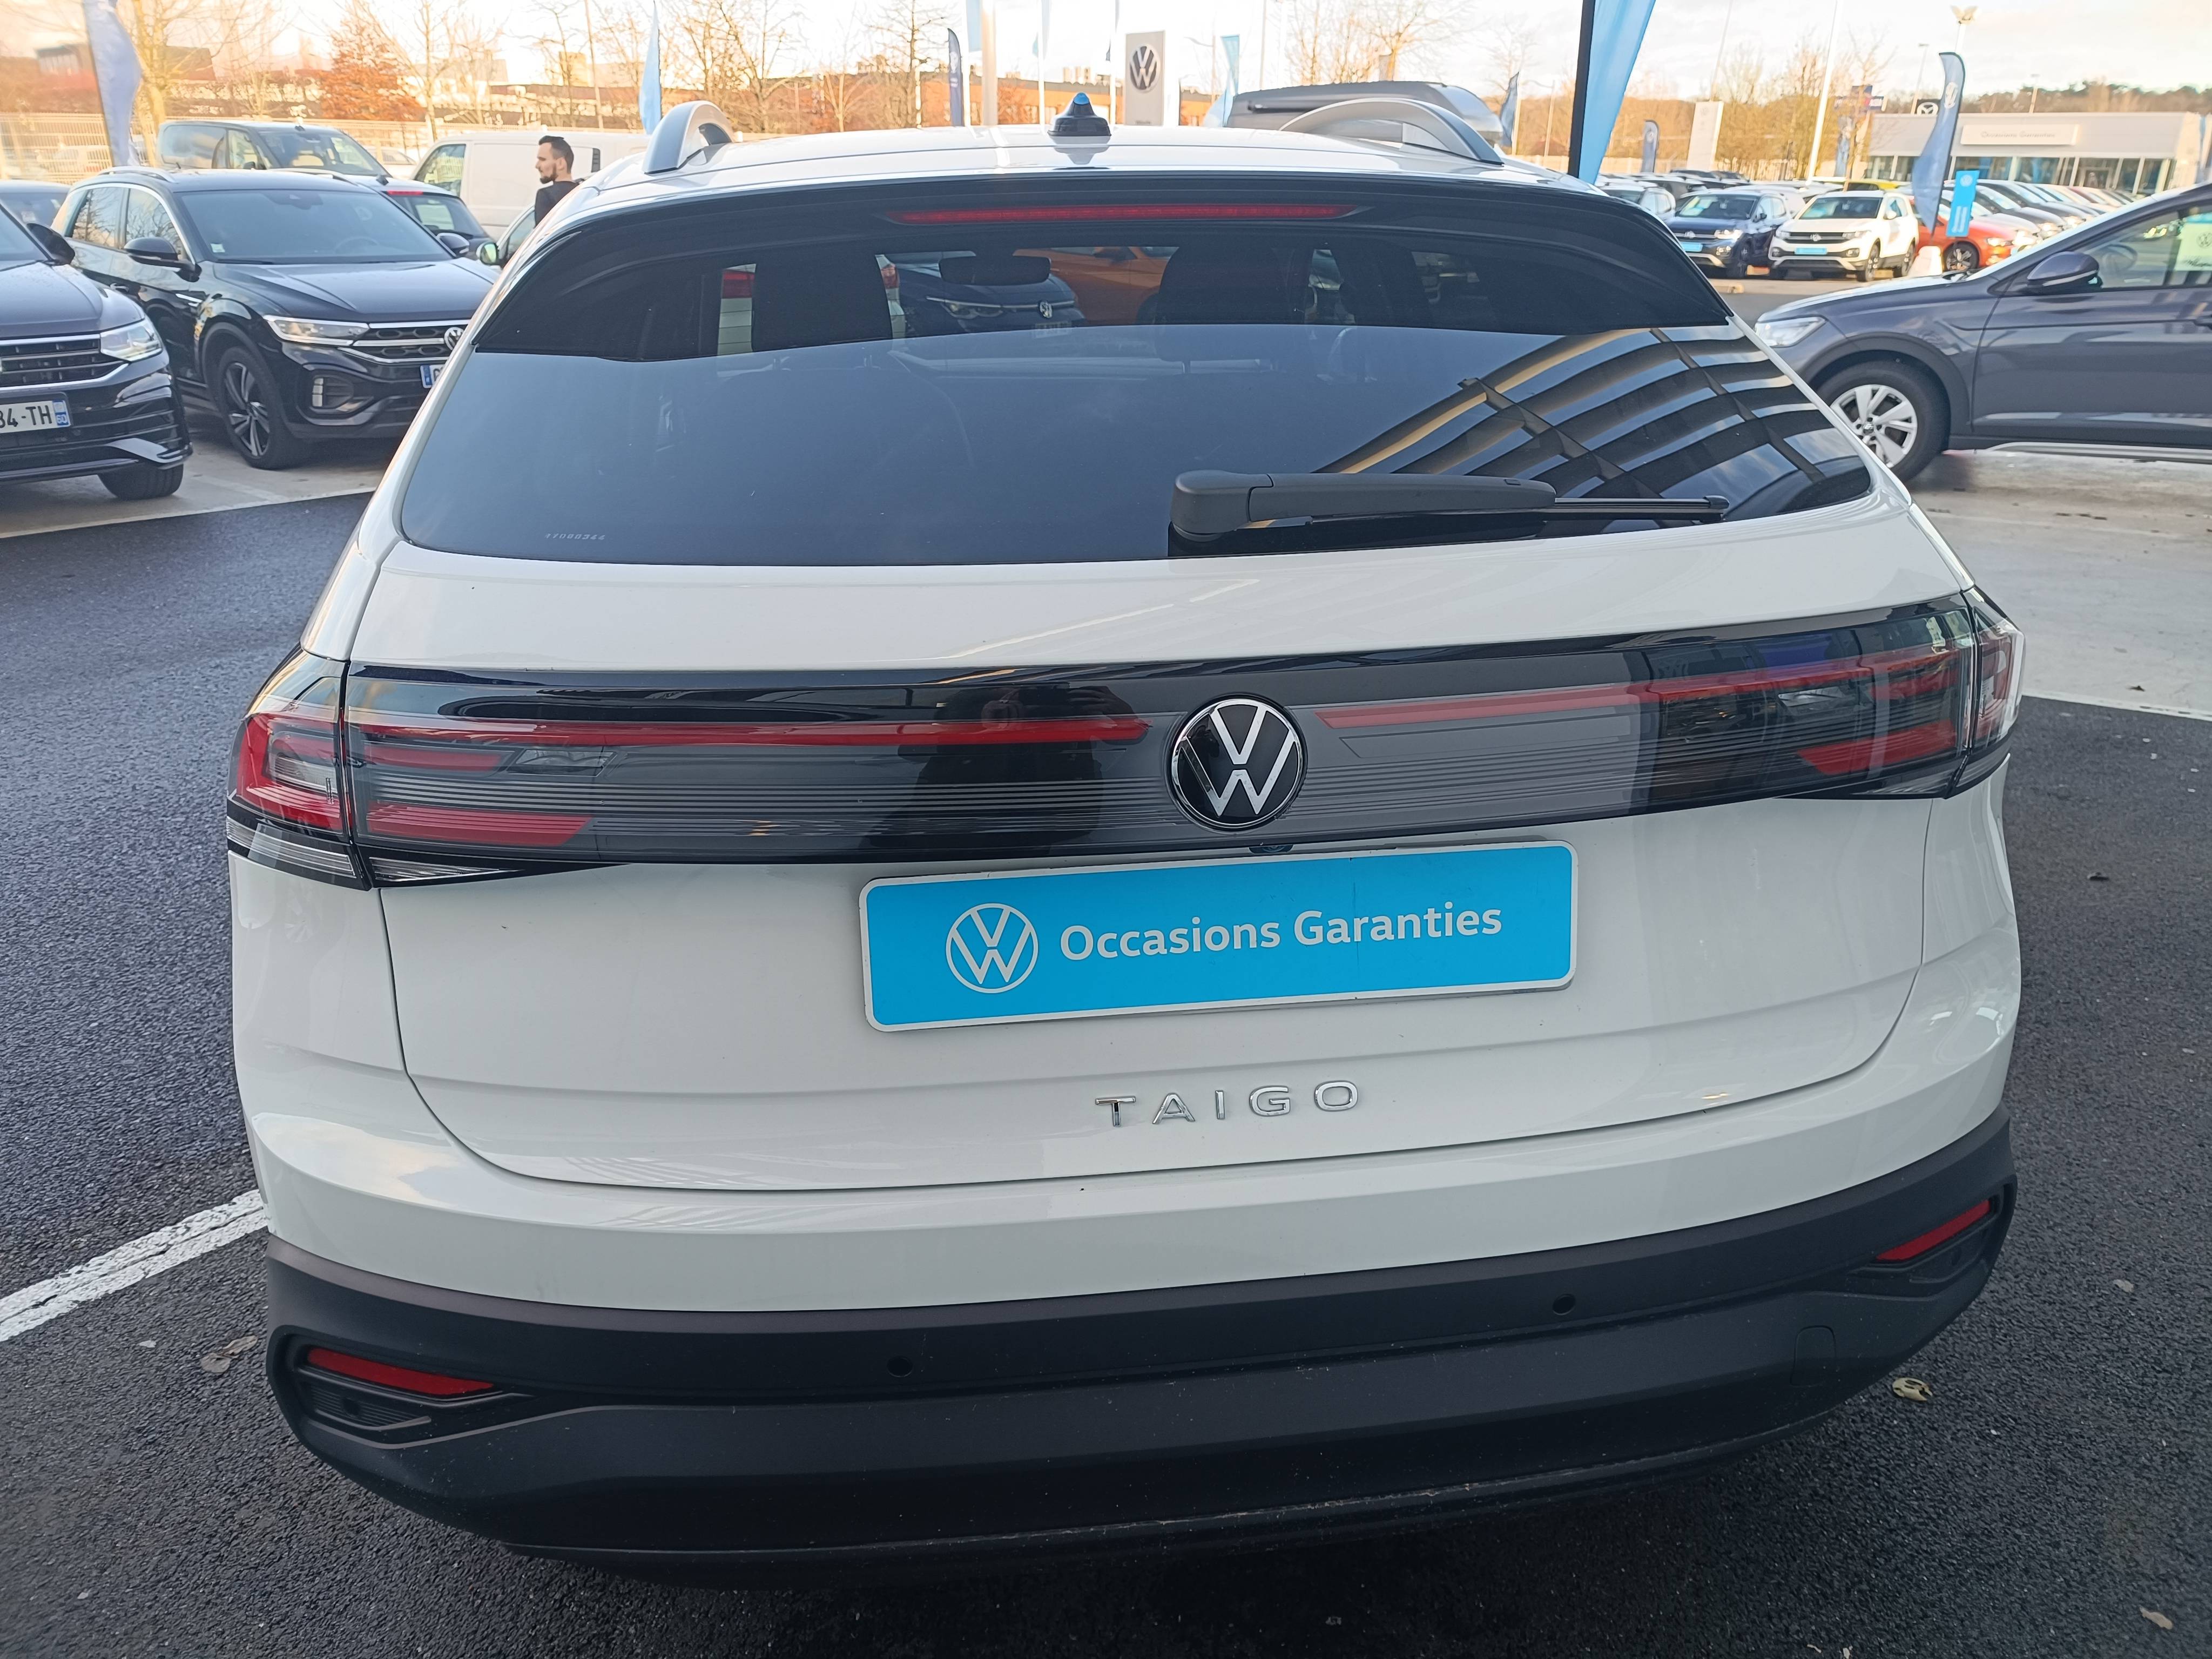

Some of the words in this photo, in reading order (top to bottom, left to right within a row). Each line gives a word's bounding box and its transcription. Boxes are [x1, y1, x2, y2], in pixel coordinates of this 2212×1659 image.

[1060, 915, 1281, 961] Occasions
[1293, 901, 1503, 946] Garanties
[1095, 1080, 1359, 1128] TAIGO
